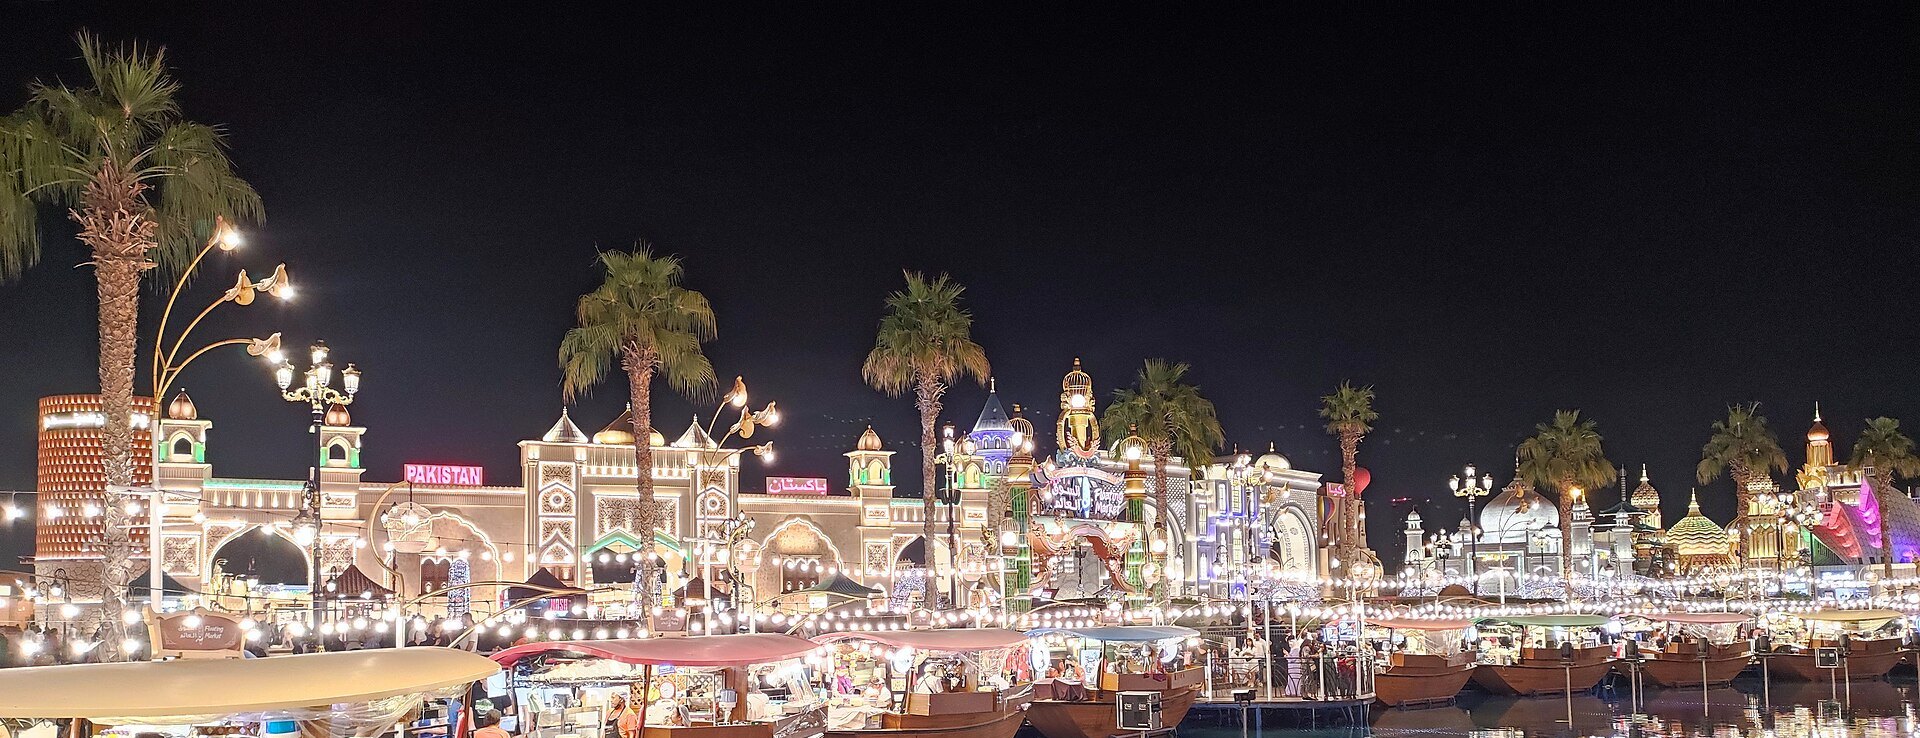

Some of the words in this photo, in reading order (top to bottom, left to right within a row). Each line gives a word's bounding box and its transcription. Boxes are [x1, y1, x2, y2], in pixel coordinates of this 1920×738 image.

[407, 465, 481, 485] PAKISTAN
[769, 478, 827, 495] باكستان
[1328, 483, 1347, 497] ركيا
